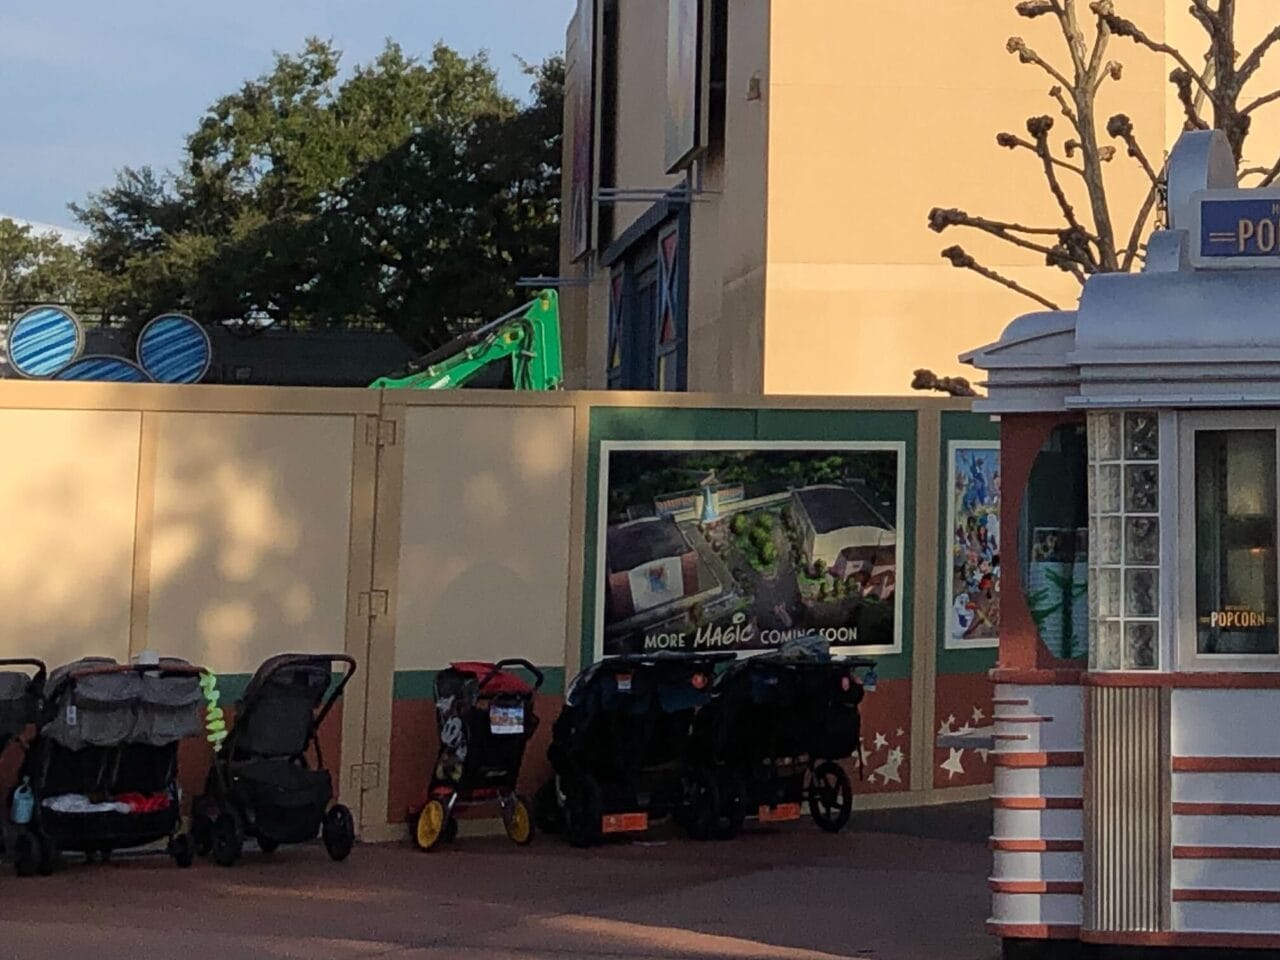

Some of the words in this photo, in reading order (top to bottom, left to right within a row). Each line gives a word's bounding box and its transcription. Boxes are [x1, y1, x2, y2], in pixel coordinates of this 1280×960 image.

[1211, 611, 1265, 627] POPCORN
[644, 633, 686, 648] MORE
[819, 627, 858, 642] SOON
